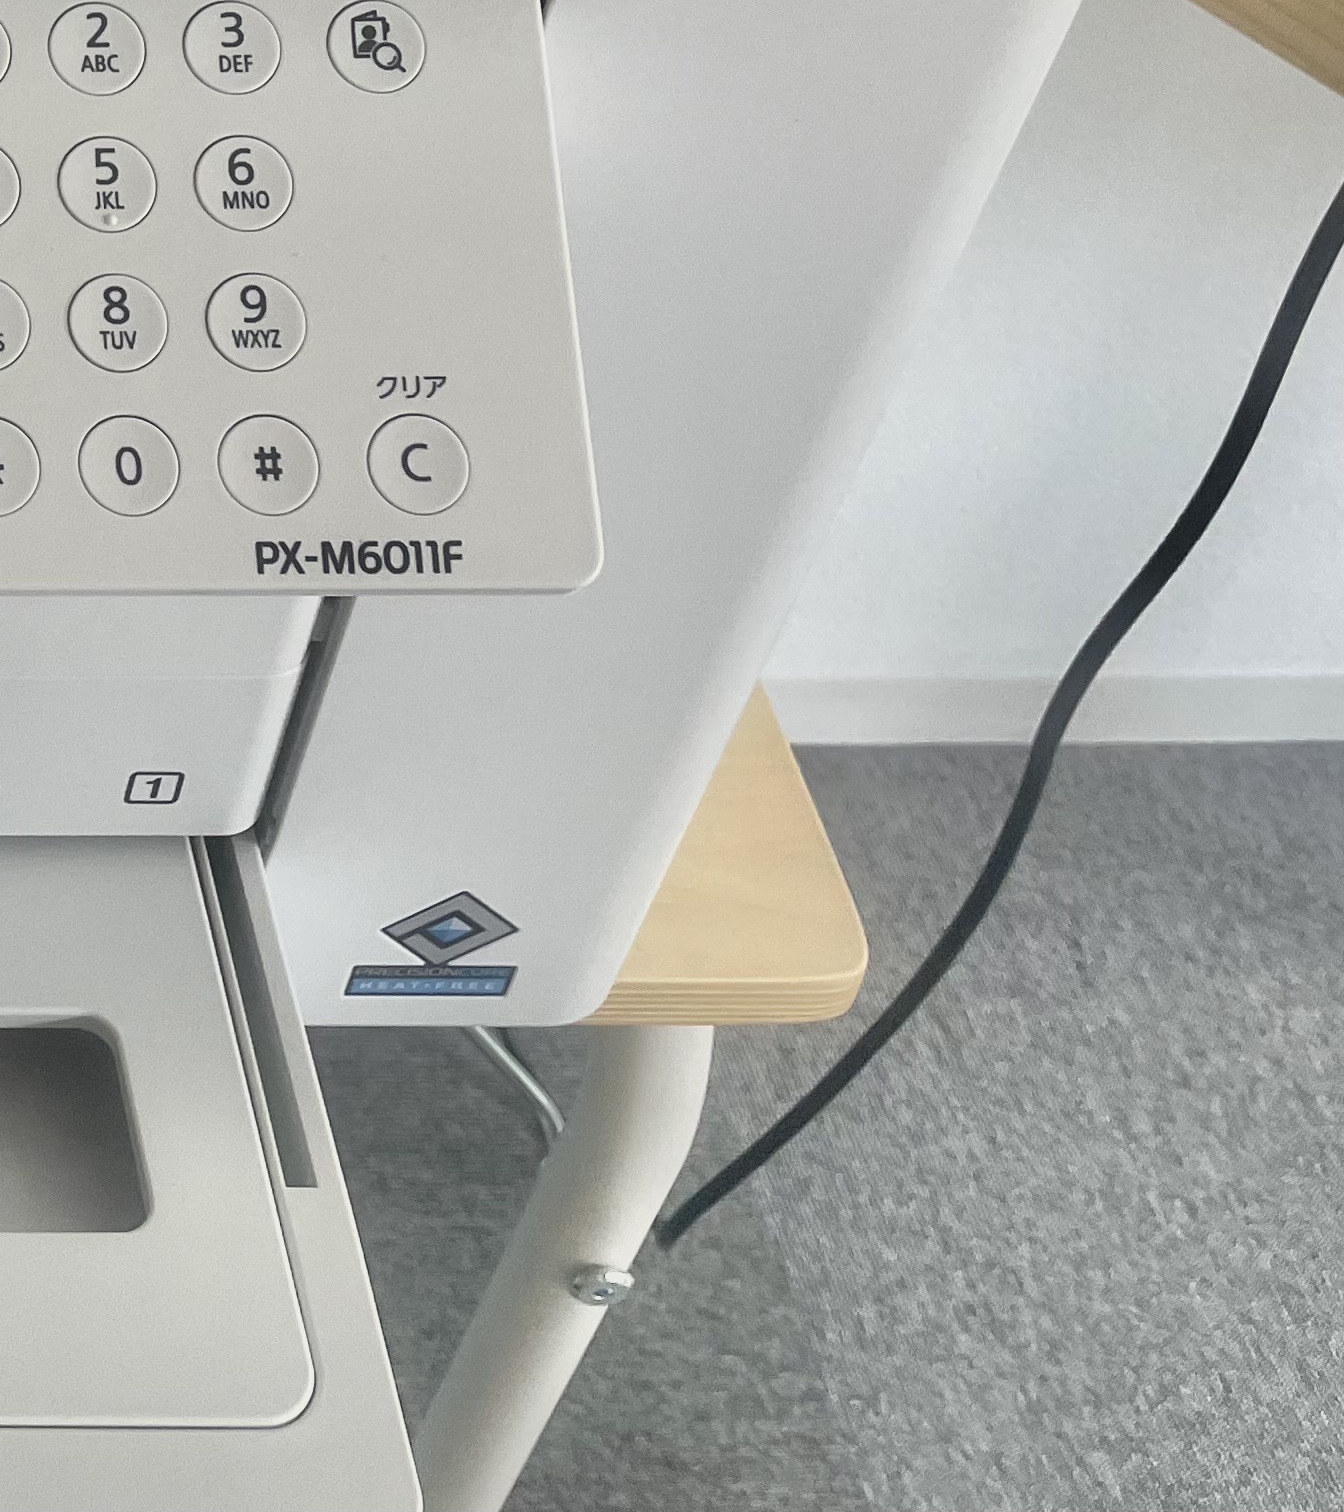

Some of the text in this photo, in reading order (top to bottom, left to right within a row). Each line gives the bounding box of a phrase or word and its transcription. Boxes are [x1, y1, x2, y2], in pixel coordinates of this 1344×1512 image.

[86, 12, 110, 48] 2
[220, 11, 245, 48] 3
[80, 54, 120, 73] ABC
[218, 55, 253, 73] DEF
[94, 147, 119, 185] 5
[228, 148, 255, 185] 6
[94, 191, 125, 210] JKL
[222, 191, 270, 210] MNO
[102, 285, 131, 325] 8
[239, 284, 267, 323] 9
[99, 330, 137, 350] TUV
[231, 329, 282, 349] WXYZ
[376, 375, 446, 399] クリア
[254, 446, 283, 482] #
[400, 443, 432, 483] C
[254, 540, 464, 575] PX-M6011F
[146, 777, 163, 799] 1
